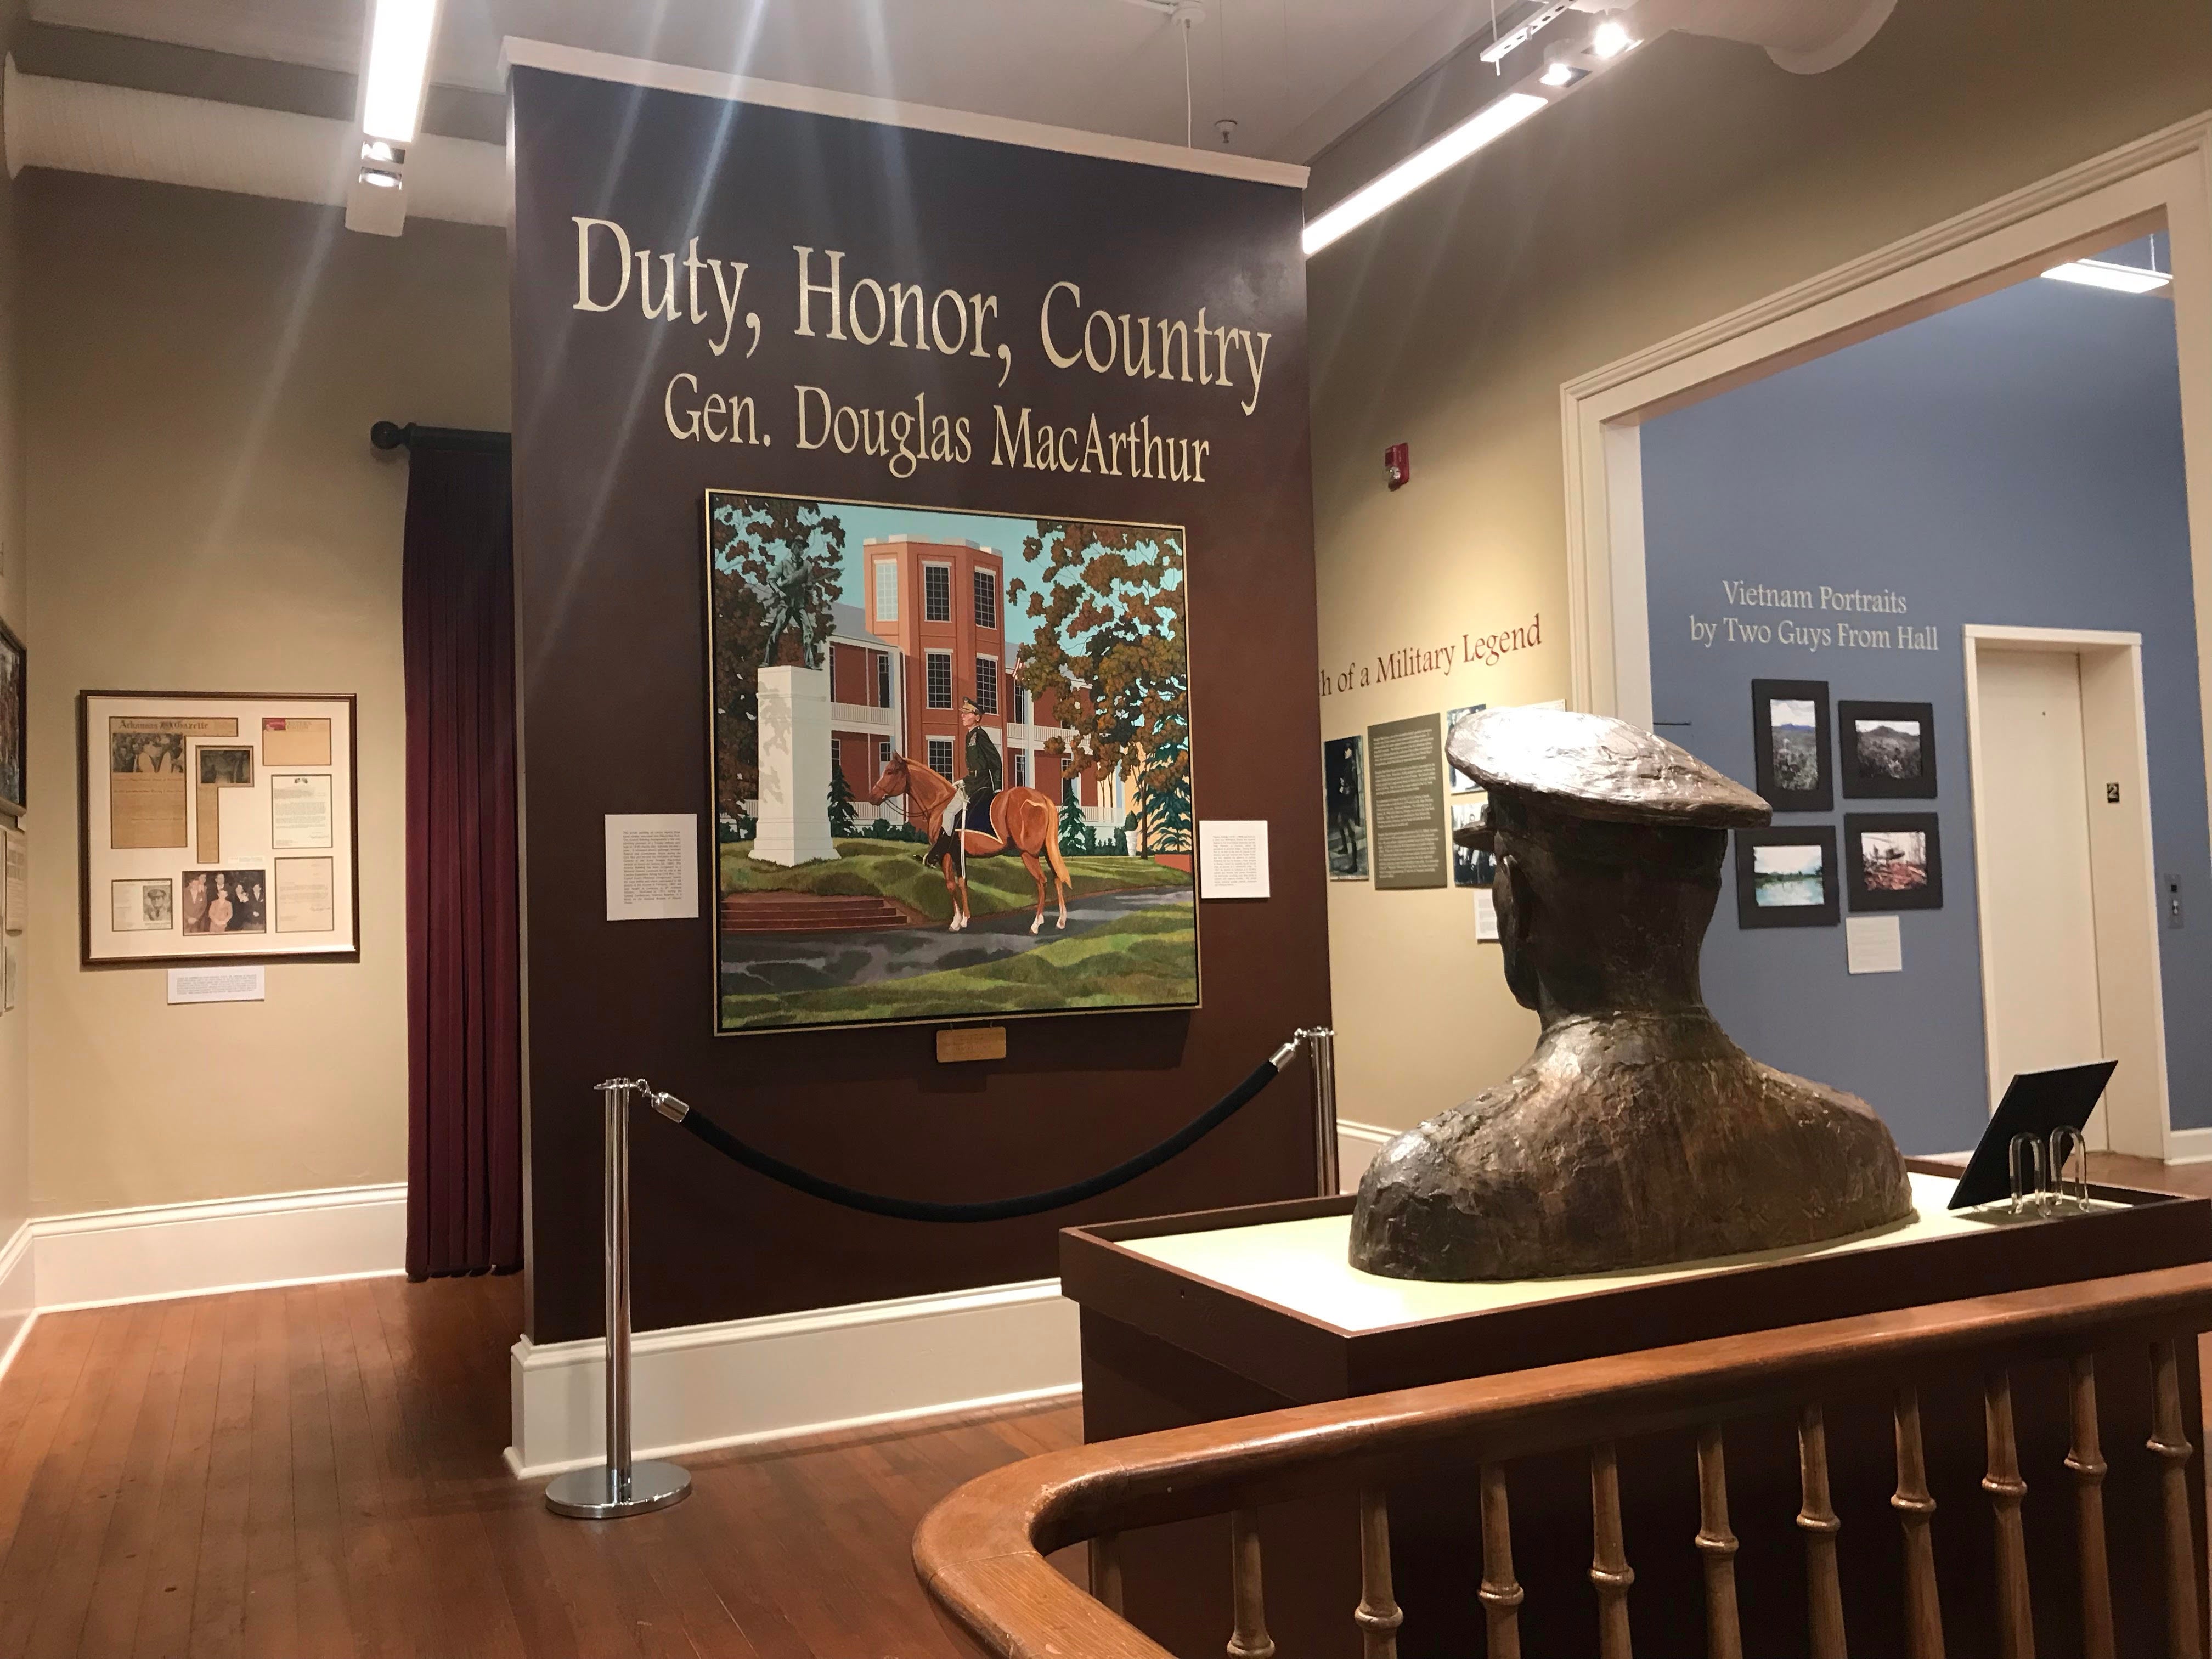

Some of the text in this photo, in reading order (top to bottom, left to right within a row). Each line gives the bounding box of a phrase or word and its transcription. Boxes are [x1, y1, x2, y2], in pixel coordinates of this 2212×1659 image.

[572, 216, 1272, 416] Duty, Honor, Country
[665, 373, 1209, 482] Gen. Douglas MacArthur
[1722, 580, 1907, 614] Vietnam Portraits
[1337, 662, 1355, 693] of
[1360, 667, 1370, 687] a
[1376, 645, 1455, 684] Military
[1462, 613, 1542, 667] Legend
[1689, 614, 1939, 652] by Two Guys From Hall
[2108, 783, 2118, 799] 2
